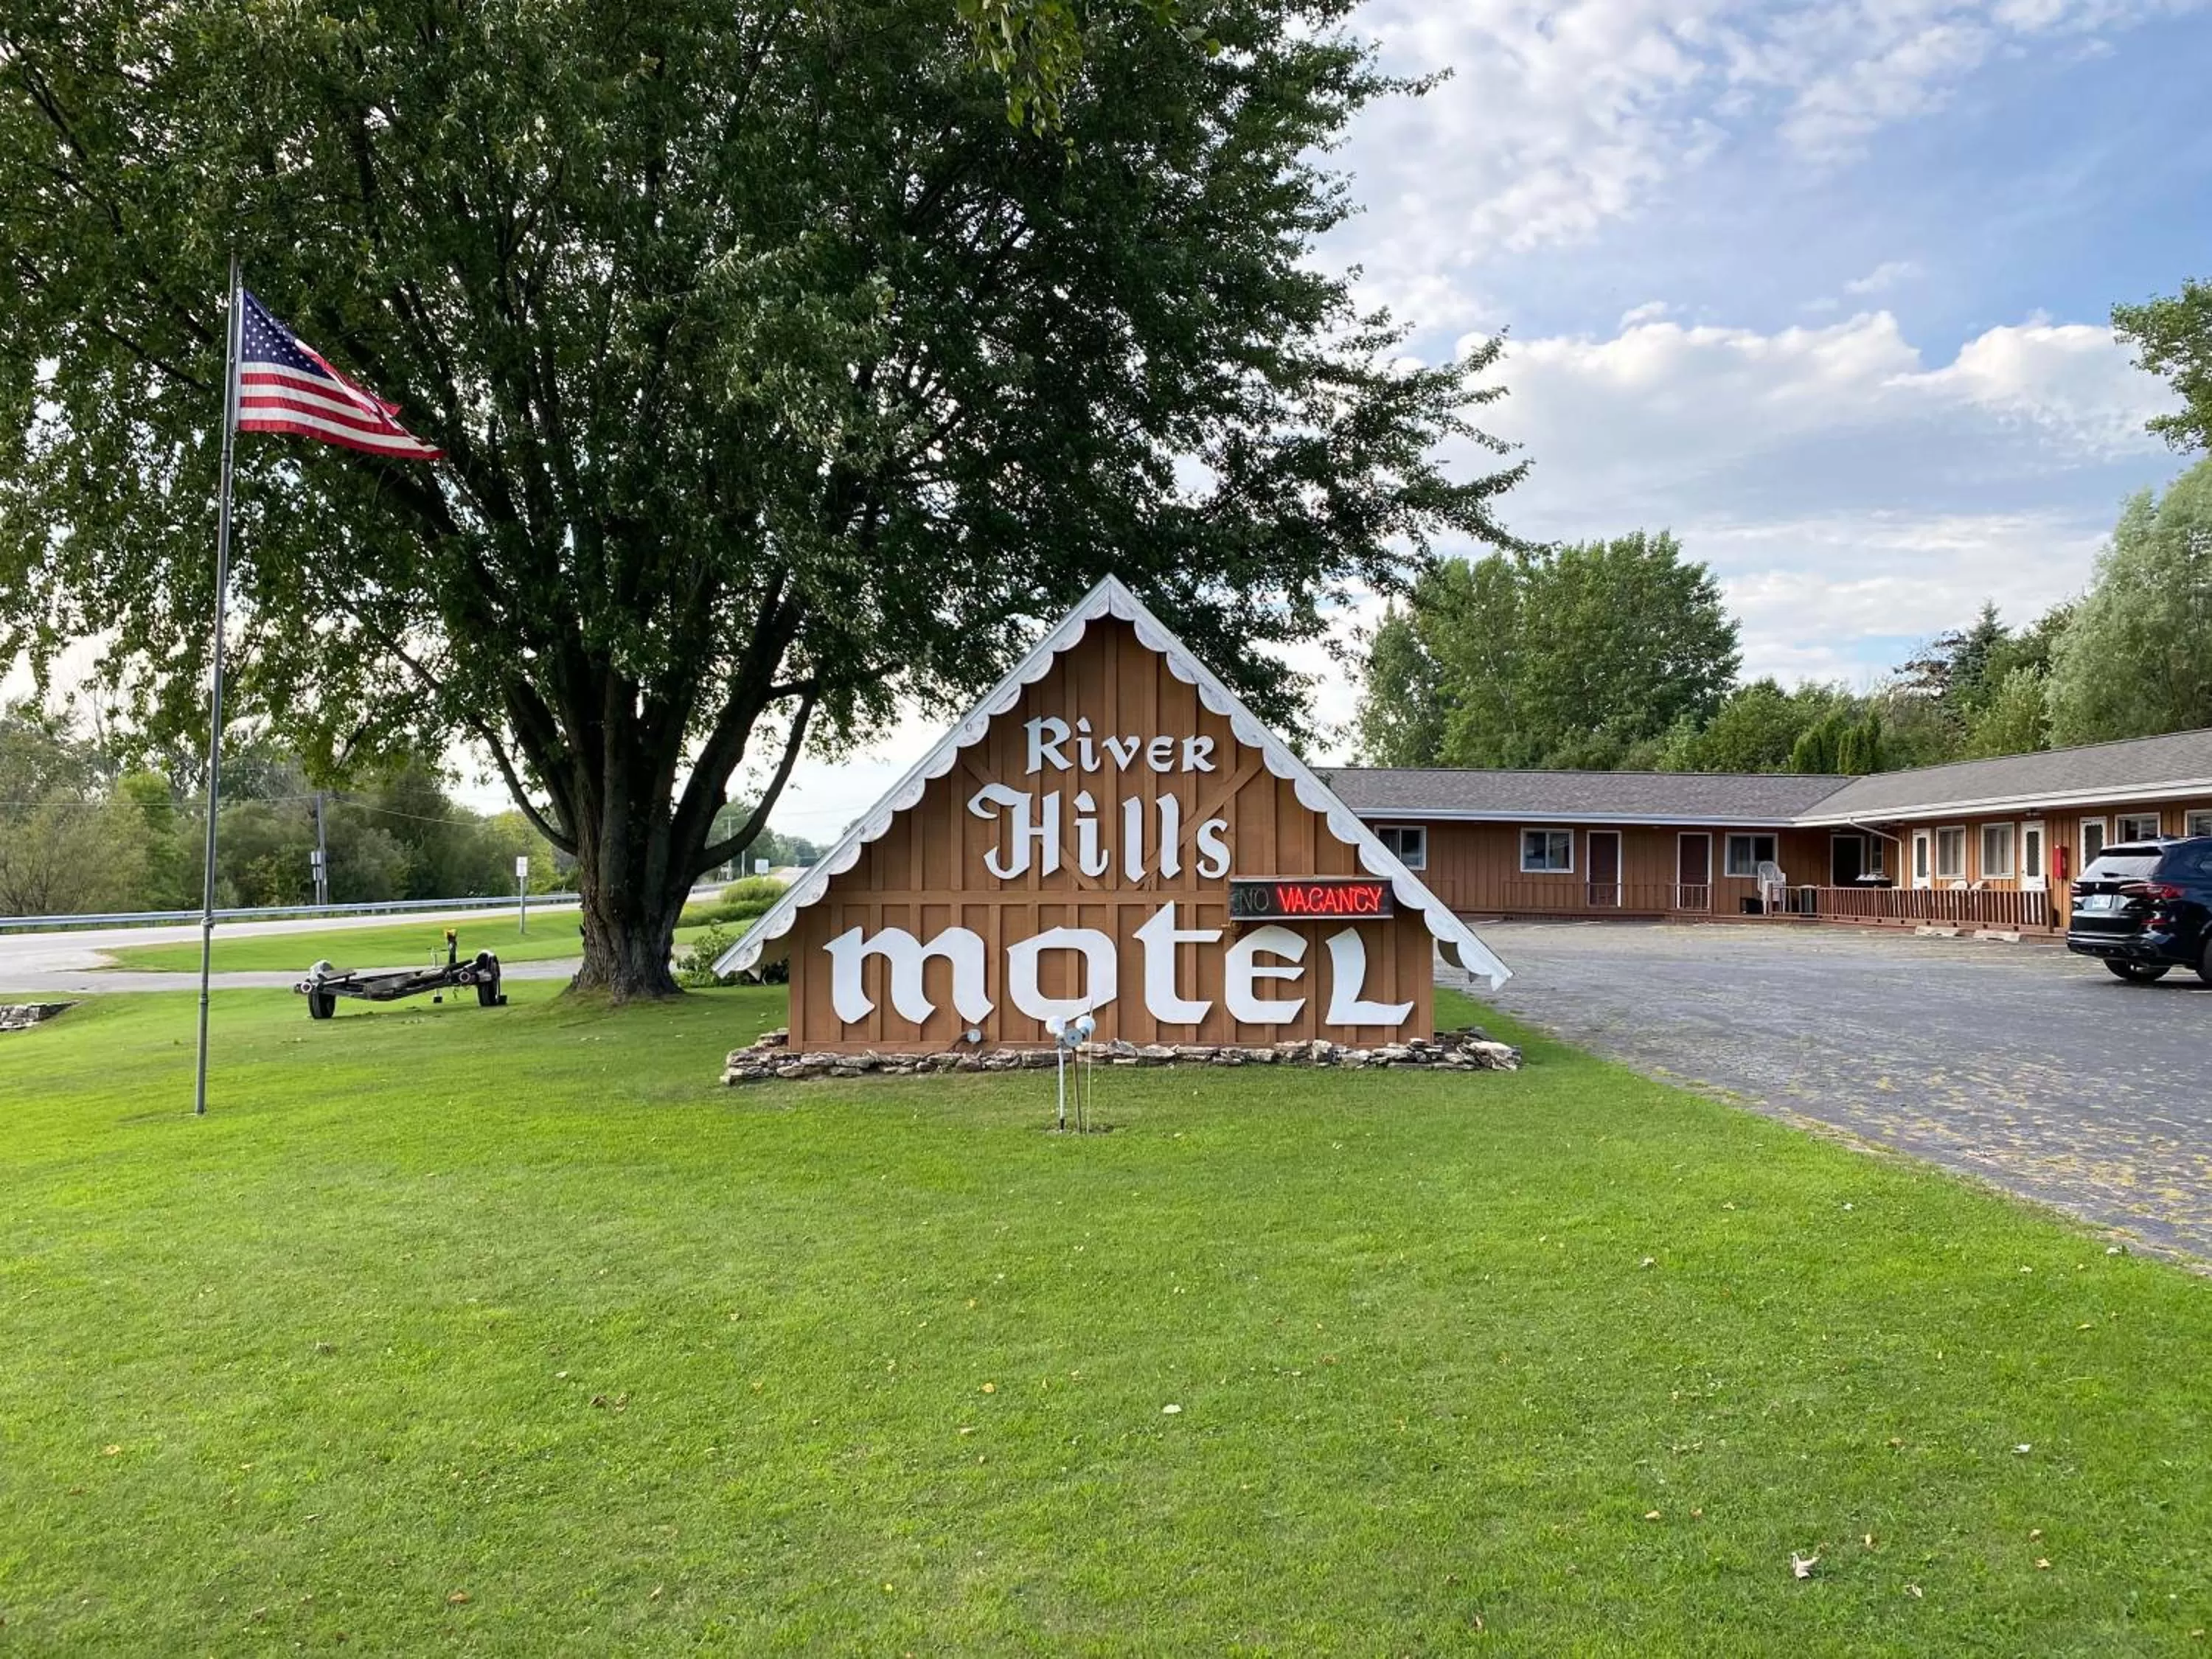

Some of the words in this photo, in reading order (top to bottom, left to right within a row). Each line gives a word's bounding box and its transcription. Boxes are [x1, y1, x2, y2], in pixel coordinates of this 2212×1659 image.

[968, 783, 1231, 881] Hills
[1238, 888, 1270, 914] NO
[1277, 886, 1382, 914] VACANCY
